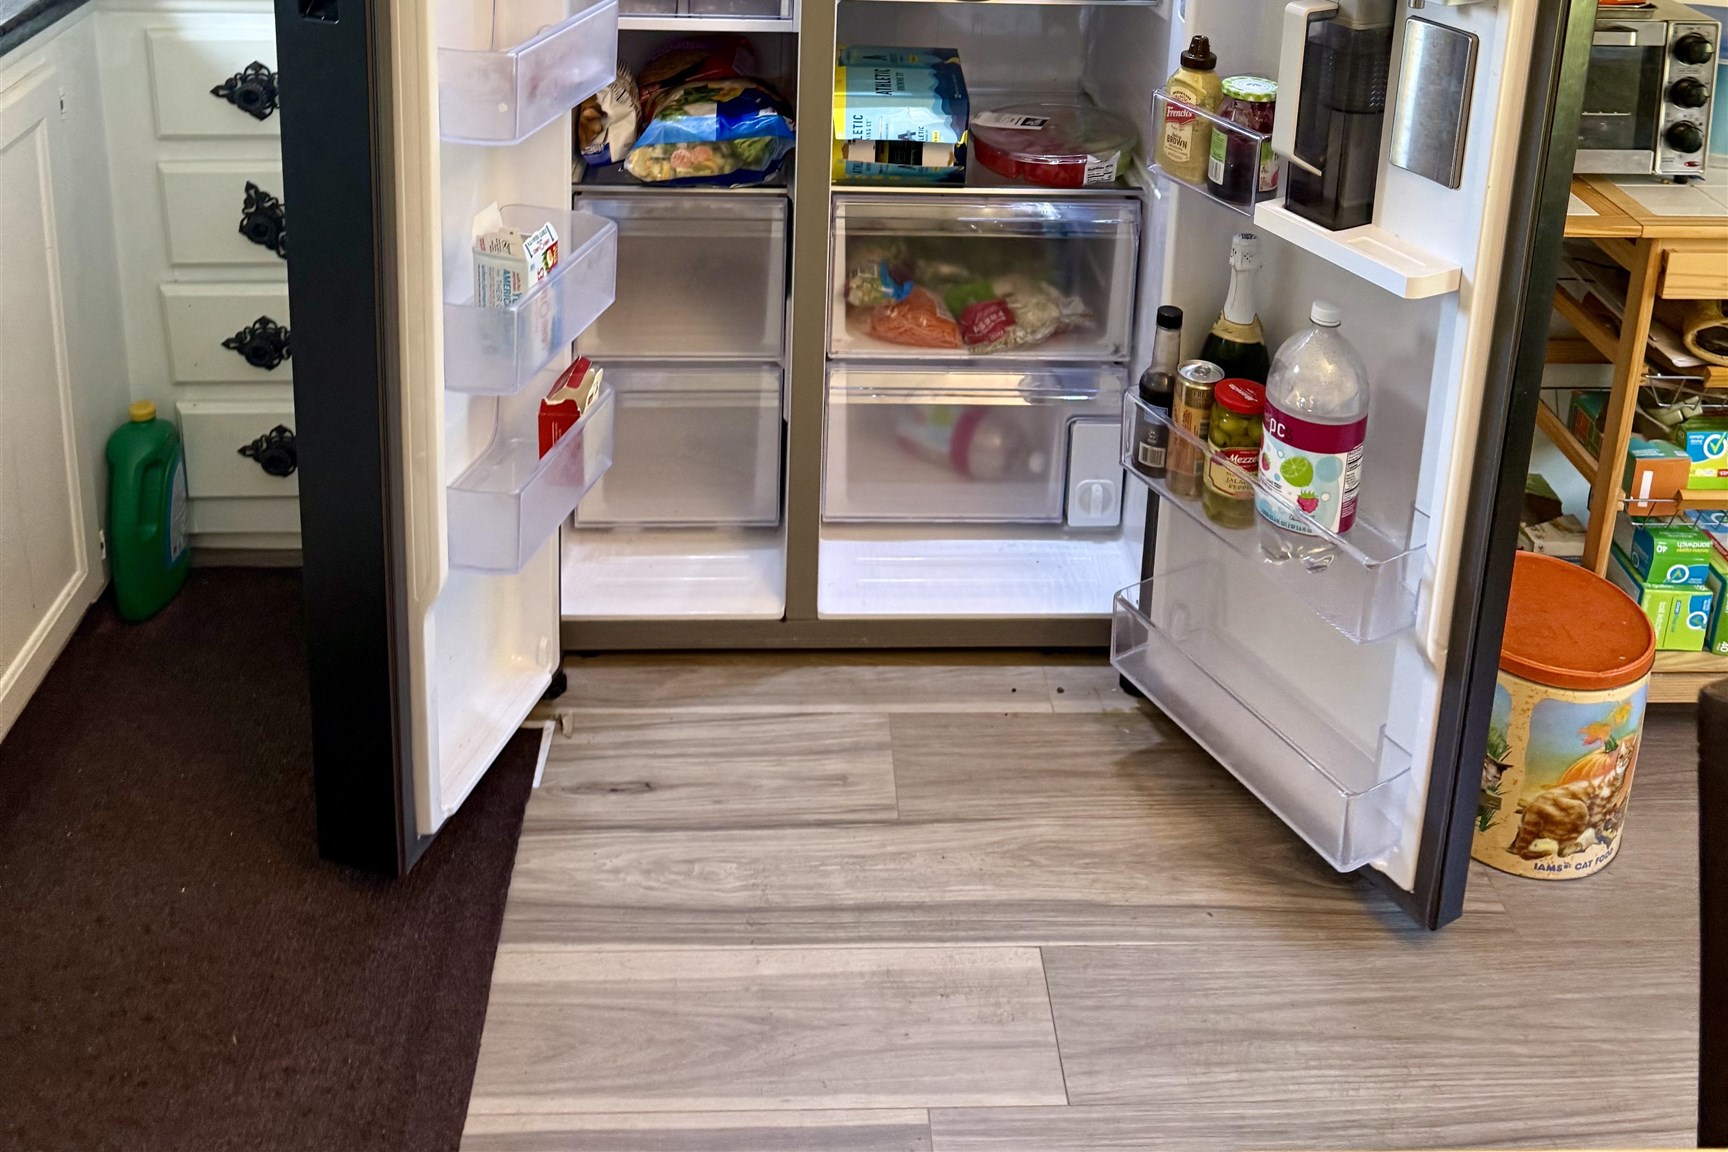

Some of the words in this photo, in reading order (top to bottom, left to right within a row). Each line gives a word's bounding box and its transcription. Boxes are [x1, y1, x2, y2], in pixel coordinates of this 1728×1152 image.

[874, 68, 892, 96] ATHLETIC
[853, 114, 864, 140] LETIC
[1166, 134, 1188, 150] BROWN
[1227, 453, 1259, 464] Mezze
[1656, 544, 1668, 553] 40
[1533, 862, 1563, 872] IAMS
[1574, 859, 1593, 870] CAT
[1595, 847, 1613, 864] FOOD
